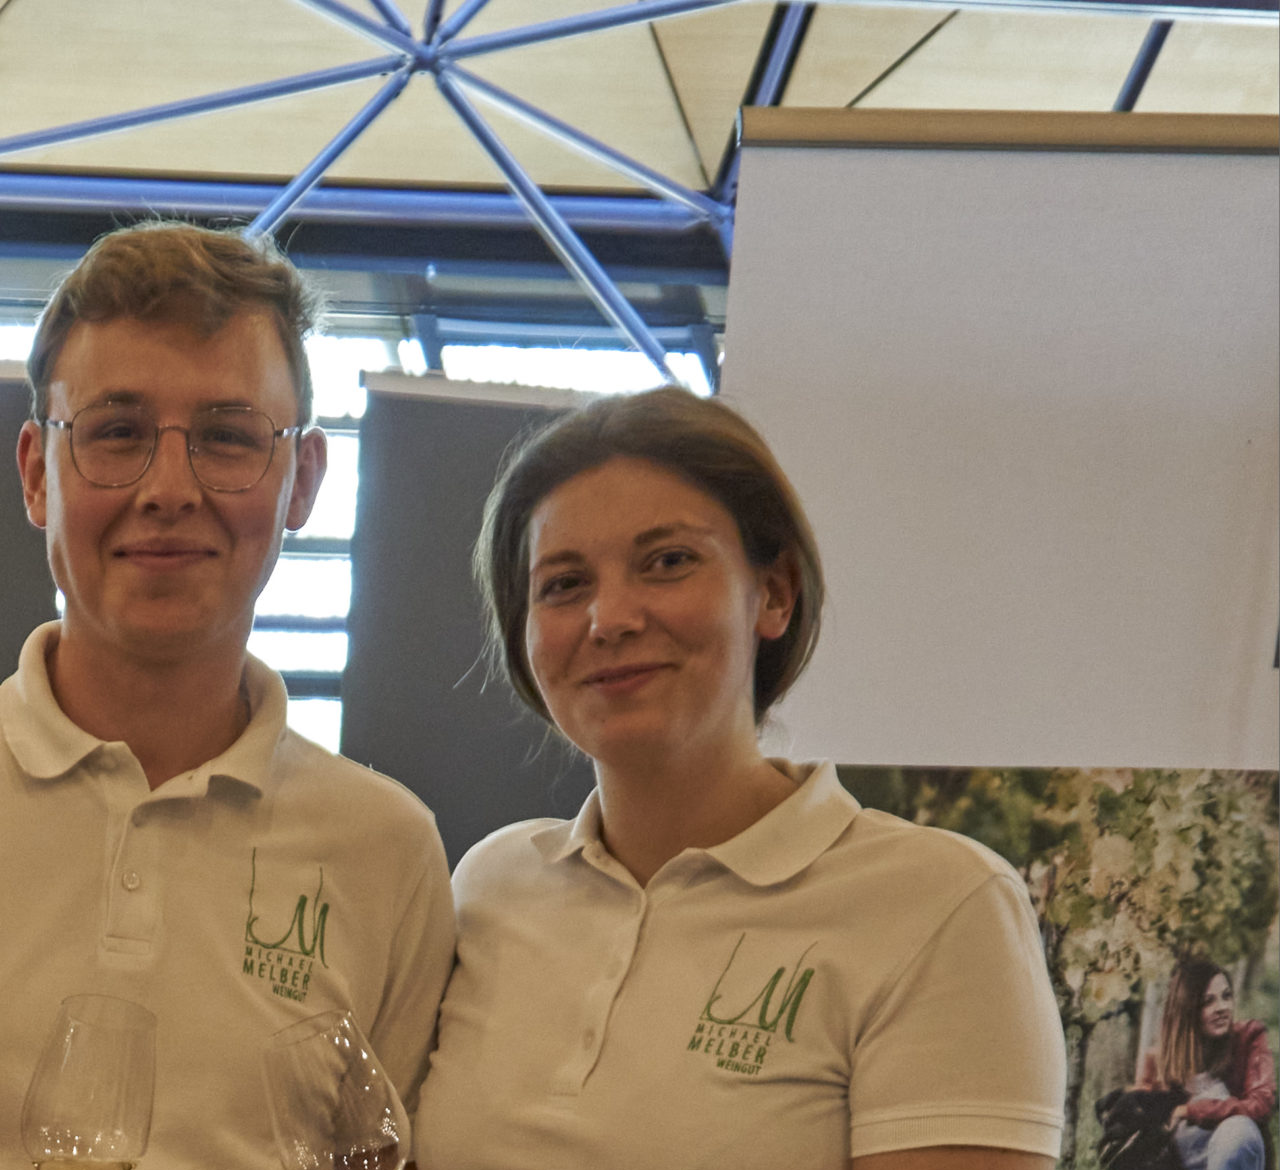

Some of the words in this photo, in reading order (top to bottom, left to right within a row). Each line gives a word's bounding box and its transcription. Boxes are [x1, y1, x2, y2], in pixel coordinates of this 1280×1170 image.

[245, 946, 313, 974] MICHAEL
[243, 957, 310, 990] MELBER
[272, 983, 308, 1003] WEINGUT
[695, 1023, 772, 1047] MICHAEL
[687, 1035, 768, 1065] MELBER
[716, 1058, 762, 1076] WEINGUT
